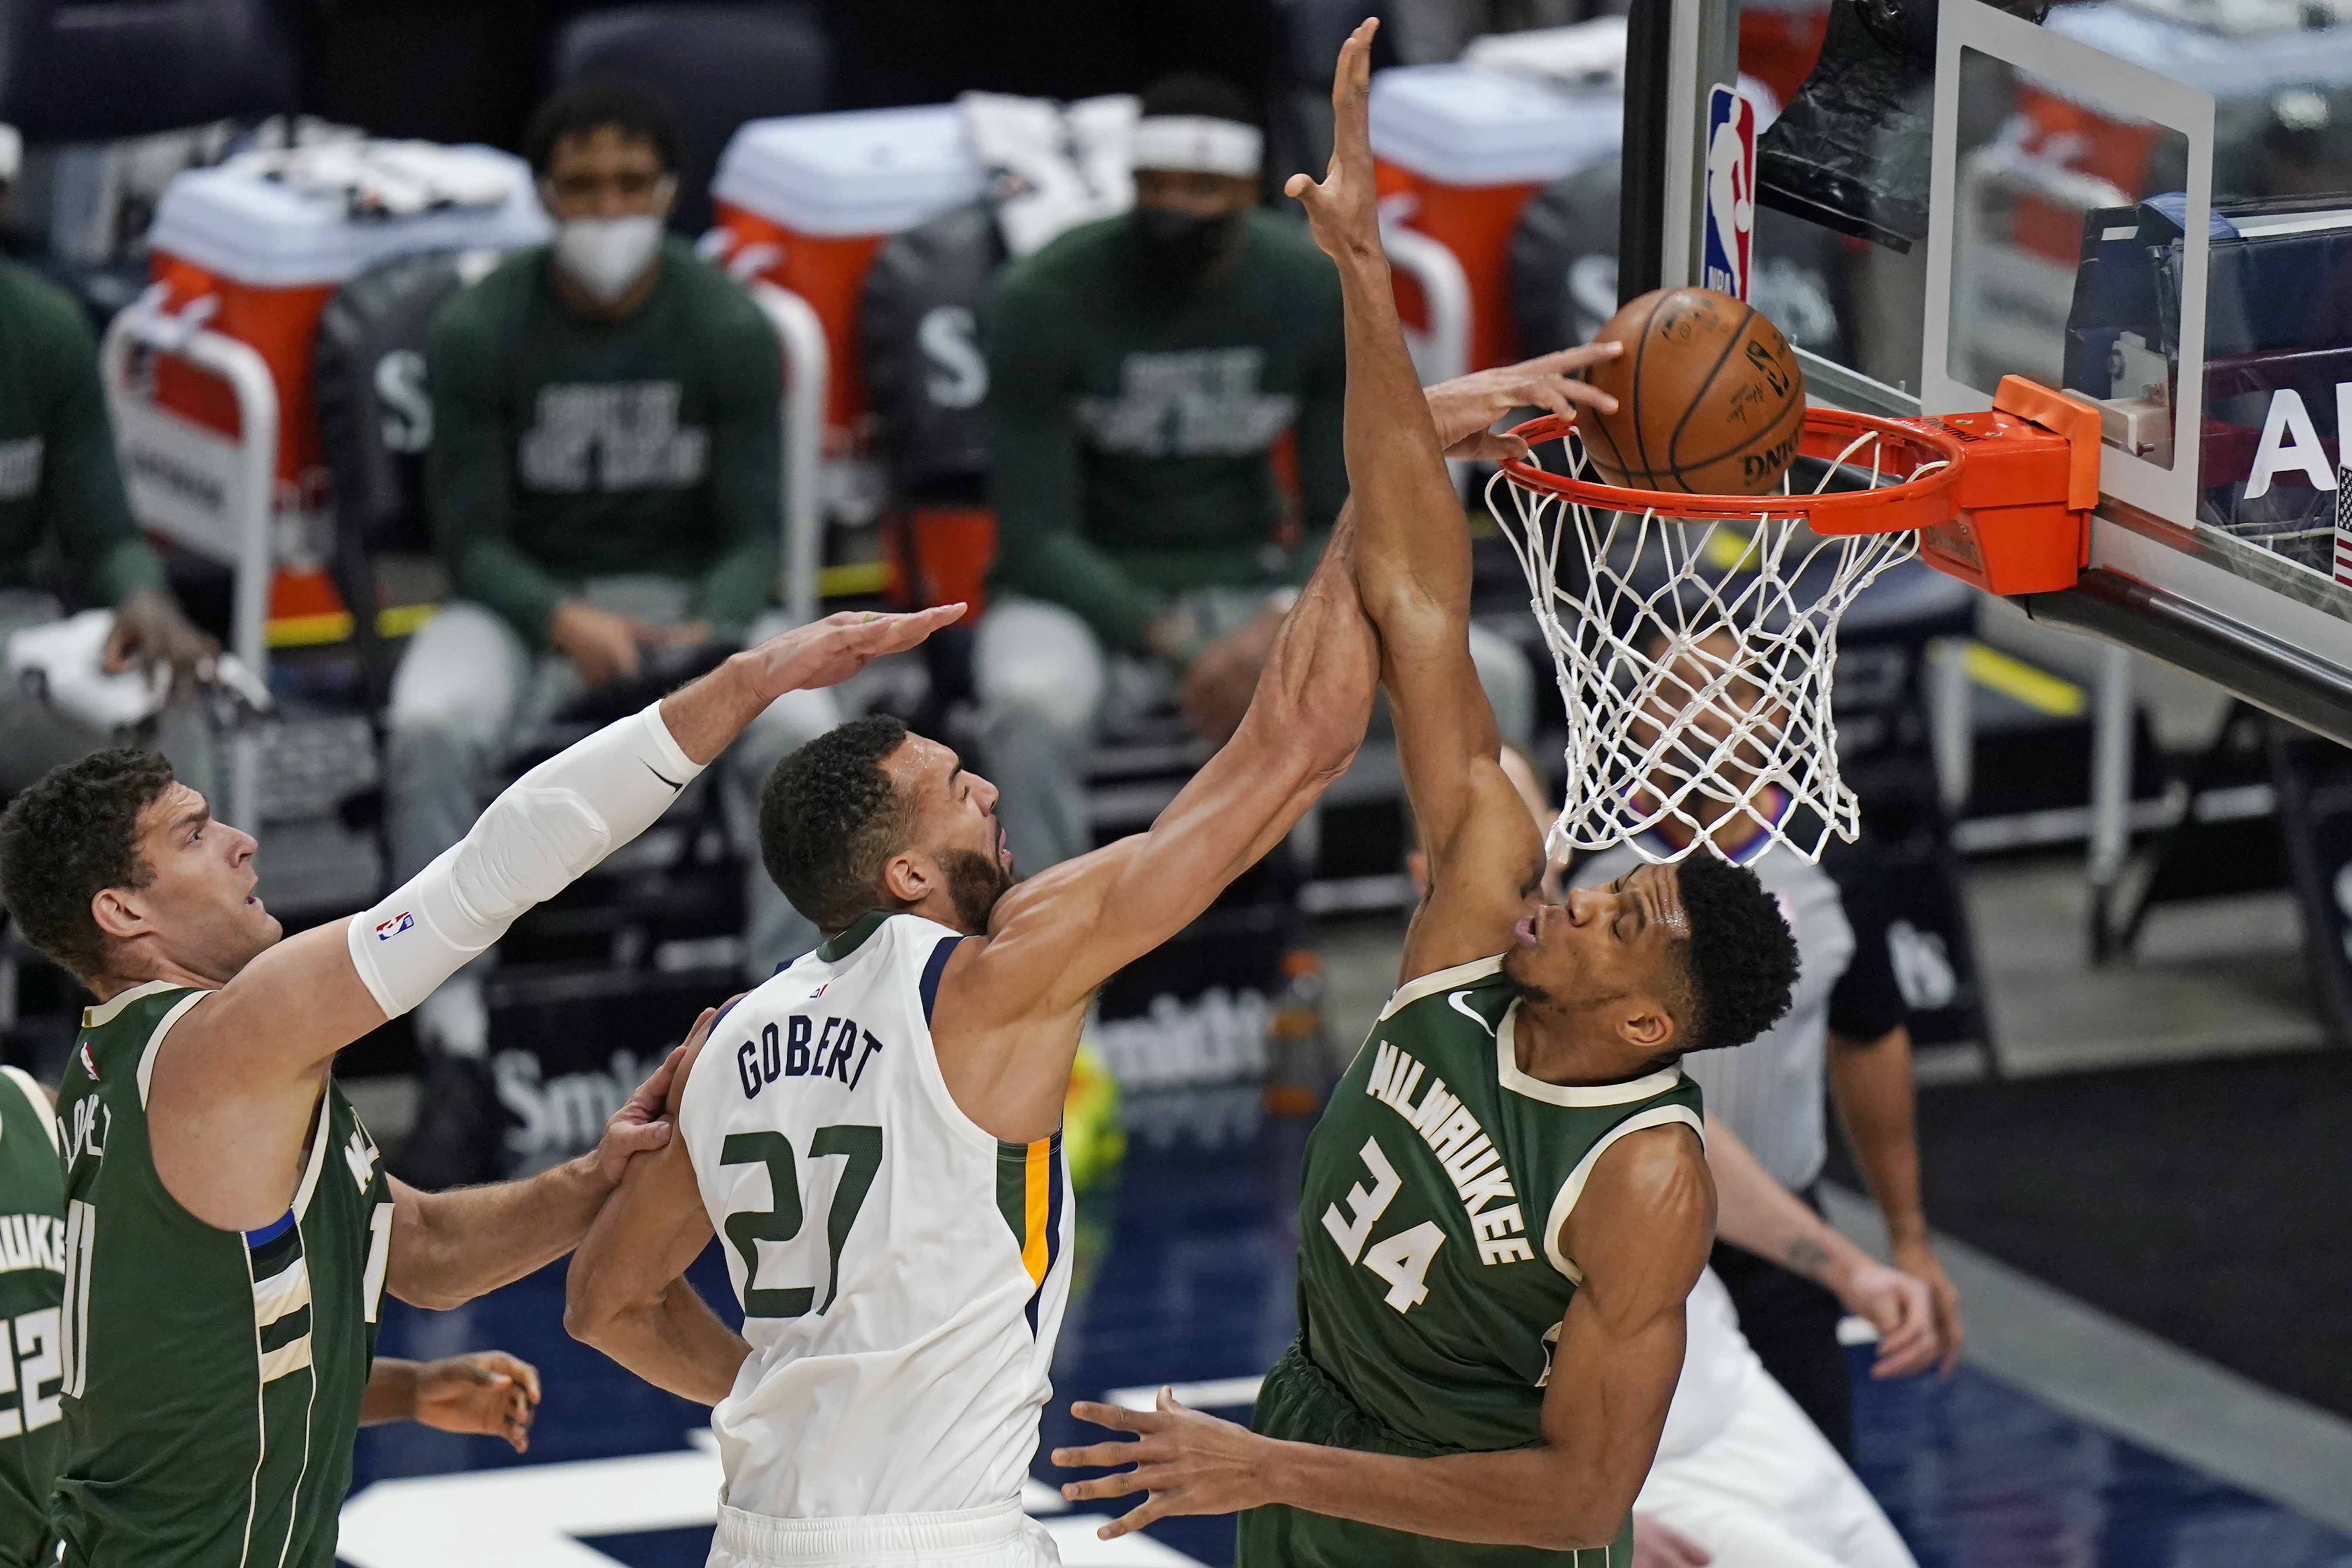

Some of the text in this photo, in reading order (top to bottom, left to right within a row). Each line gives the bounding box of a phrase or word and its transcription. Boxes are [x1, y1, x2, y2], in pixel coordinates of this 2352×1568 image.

[2243, 382, 2352, 500] A
[737, 1014, 883, 1100] GOBERT
[719, 1125, 883, 1318] 27
[1321, 1135, 1446, 1314] 34
[1365, 1039, 1535, 1266] MILWAUKEE
